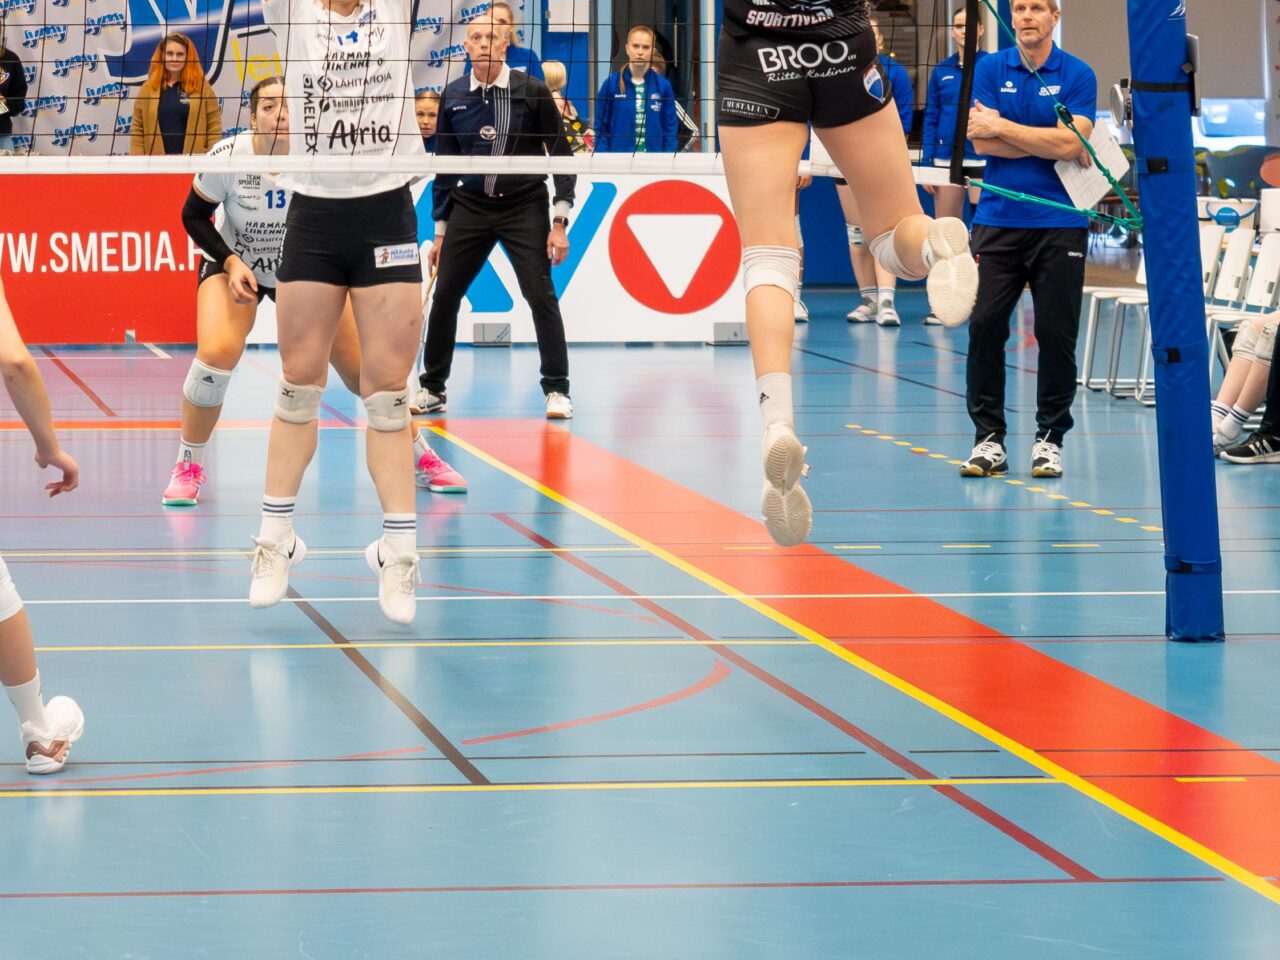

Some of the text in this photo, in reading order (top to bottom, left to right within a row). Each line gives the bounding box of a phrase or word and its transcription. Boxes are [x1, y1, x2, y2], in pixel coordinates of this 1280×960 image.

[758, 40, 849, 73] BROO
[326, 119, 393, 150] Atria
[264, 190, 286, 209] 13
